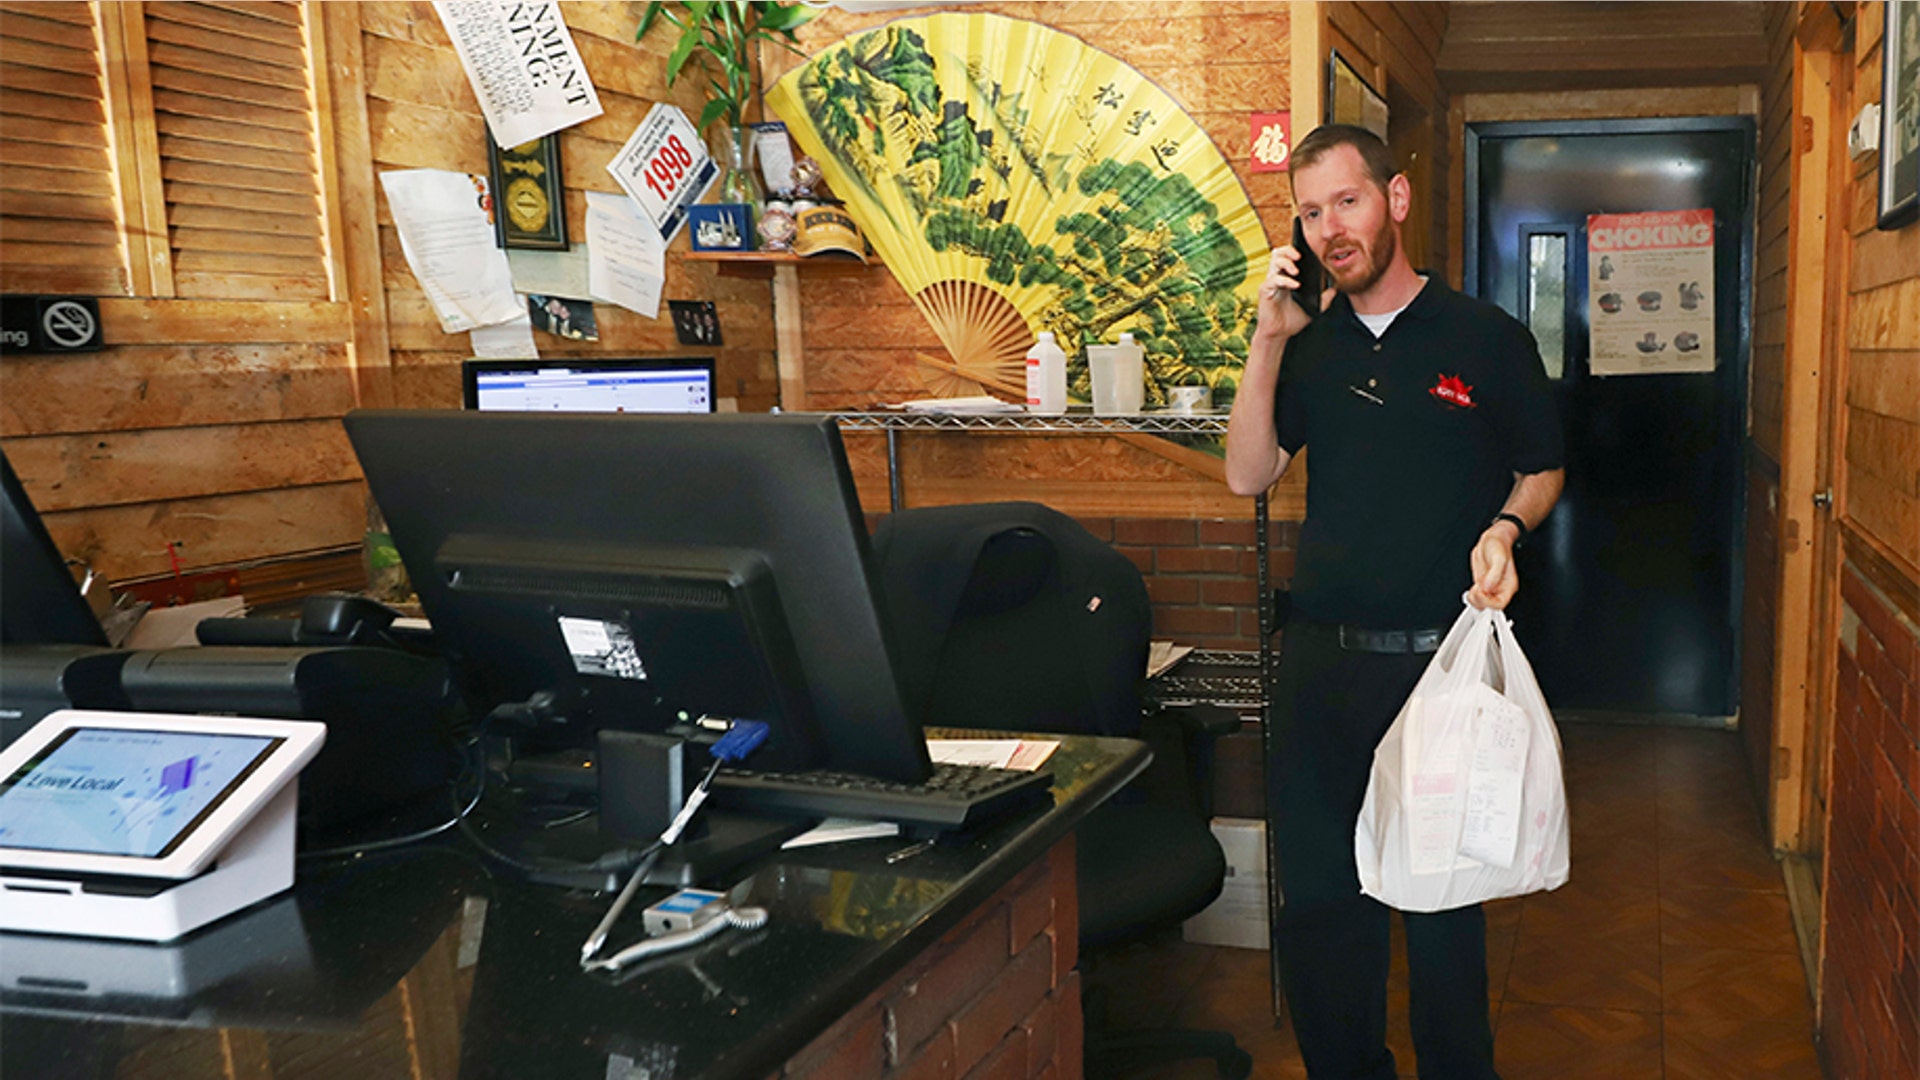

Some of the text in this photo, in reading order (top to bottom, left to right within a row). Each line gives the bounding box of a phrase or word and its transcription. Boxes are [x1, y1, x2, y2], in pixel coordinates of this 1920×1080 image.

[642, 133, 694, 201] 1998
[1591, 223, 1711, 248] CHOKING
[26, 772, 126, 791] Love Local
